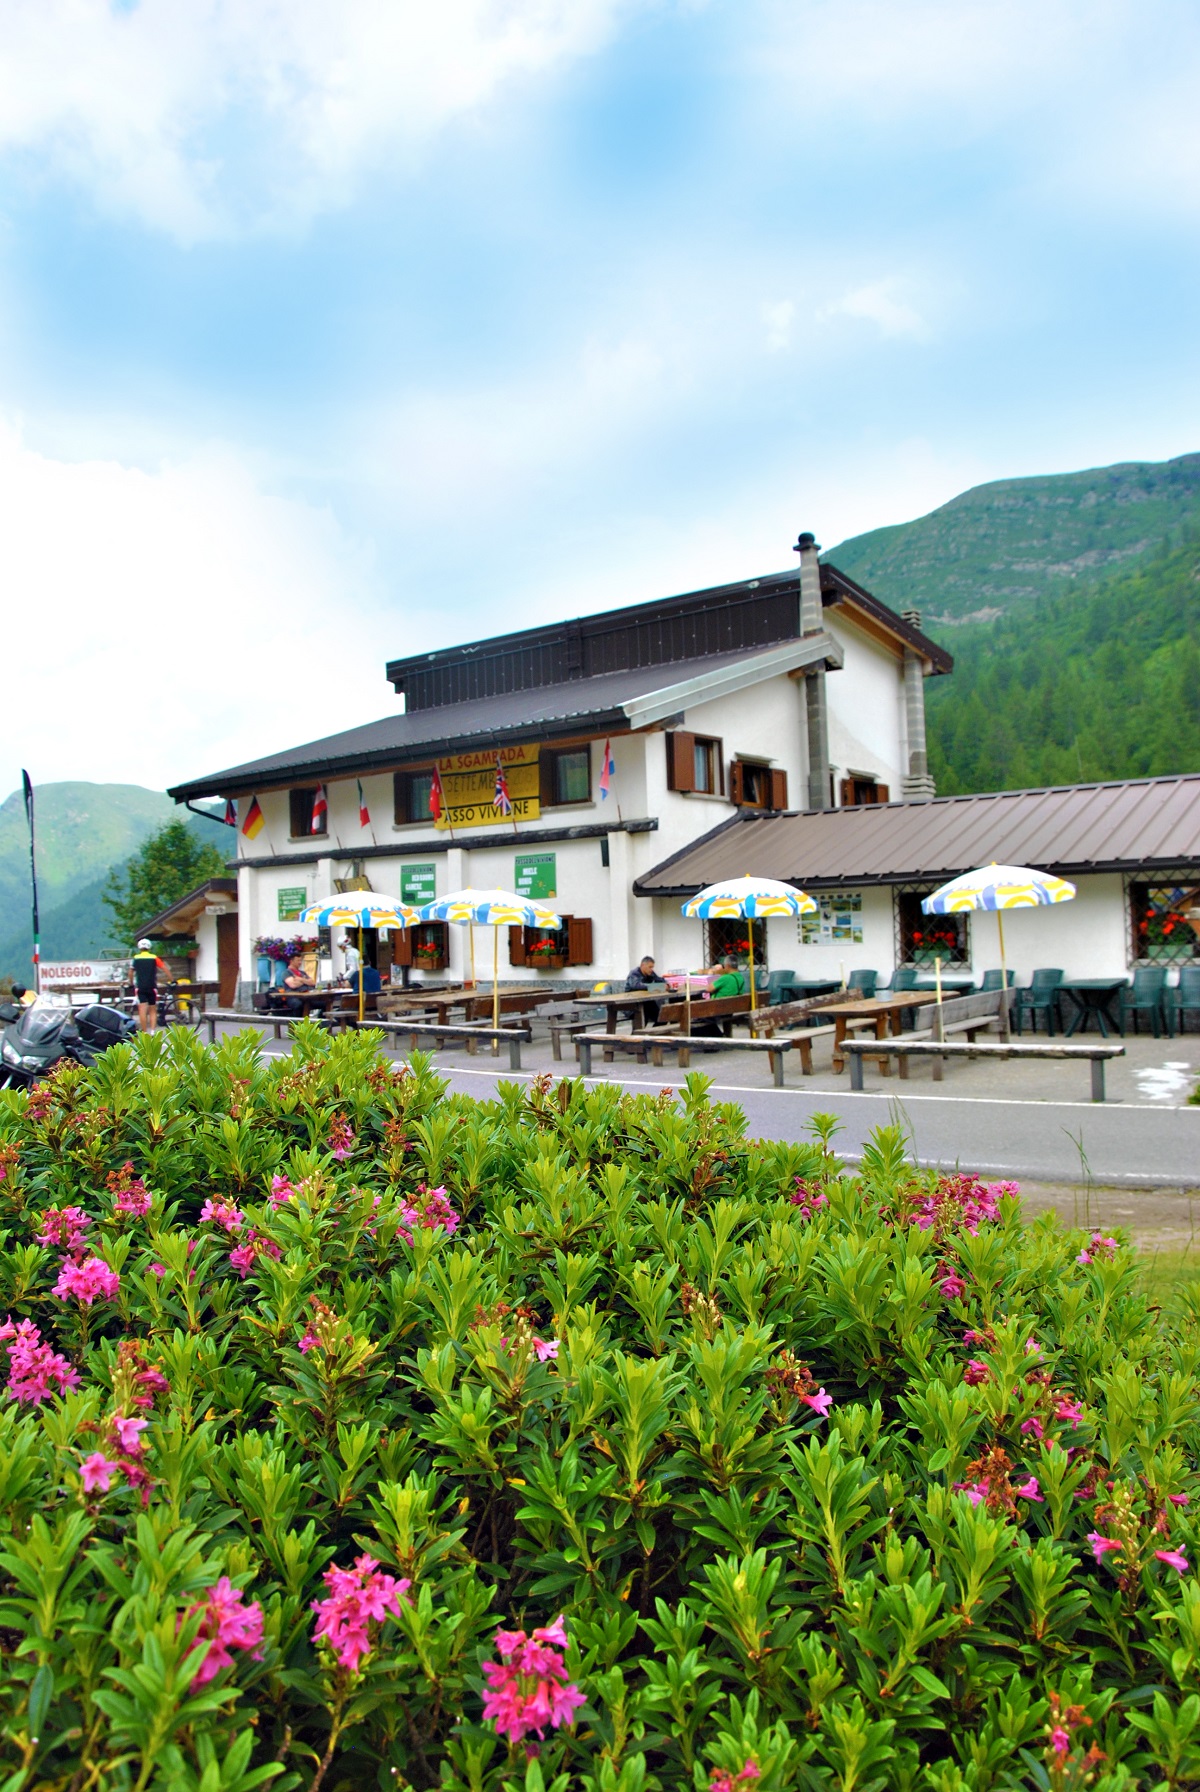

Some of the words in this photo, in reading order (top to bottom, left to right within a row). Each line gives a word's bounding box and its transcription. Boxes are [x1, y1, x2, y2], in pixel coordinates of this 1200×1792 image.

[440, 759, 453, 771] LA
[457, 747, 525, 768] SGAMBADA
[447, 770, 510, 792] SETTEMBE
[439, 808, 475, 823] ASSO
[41, 966, 92, 978] NOLEGGIO
